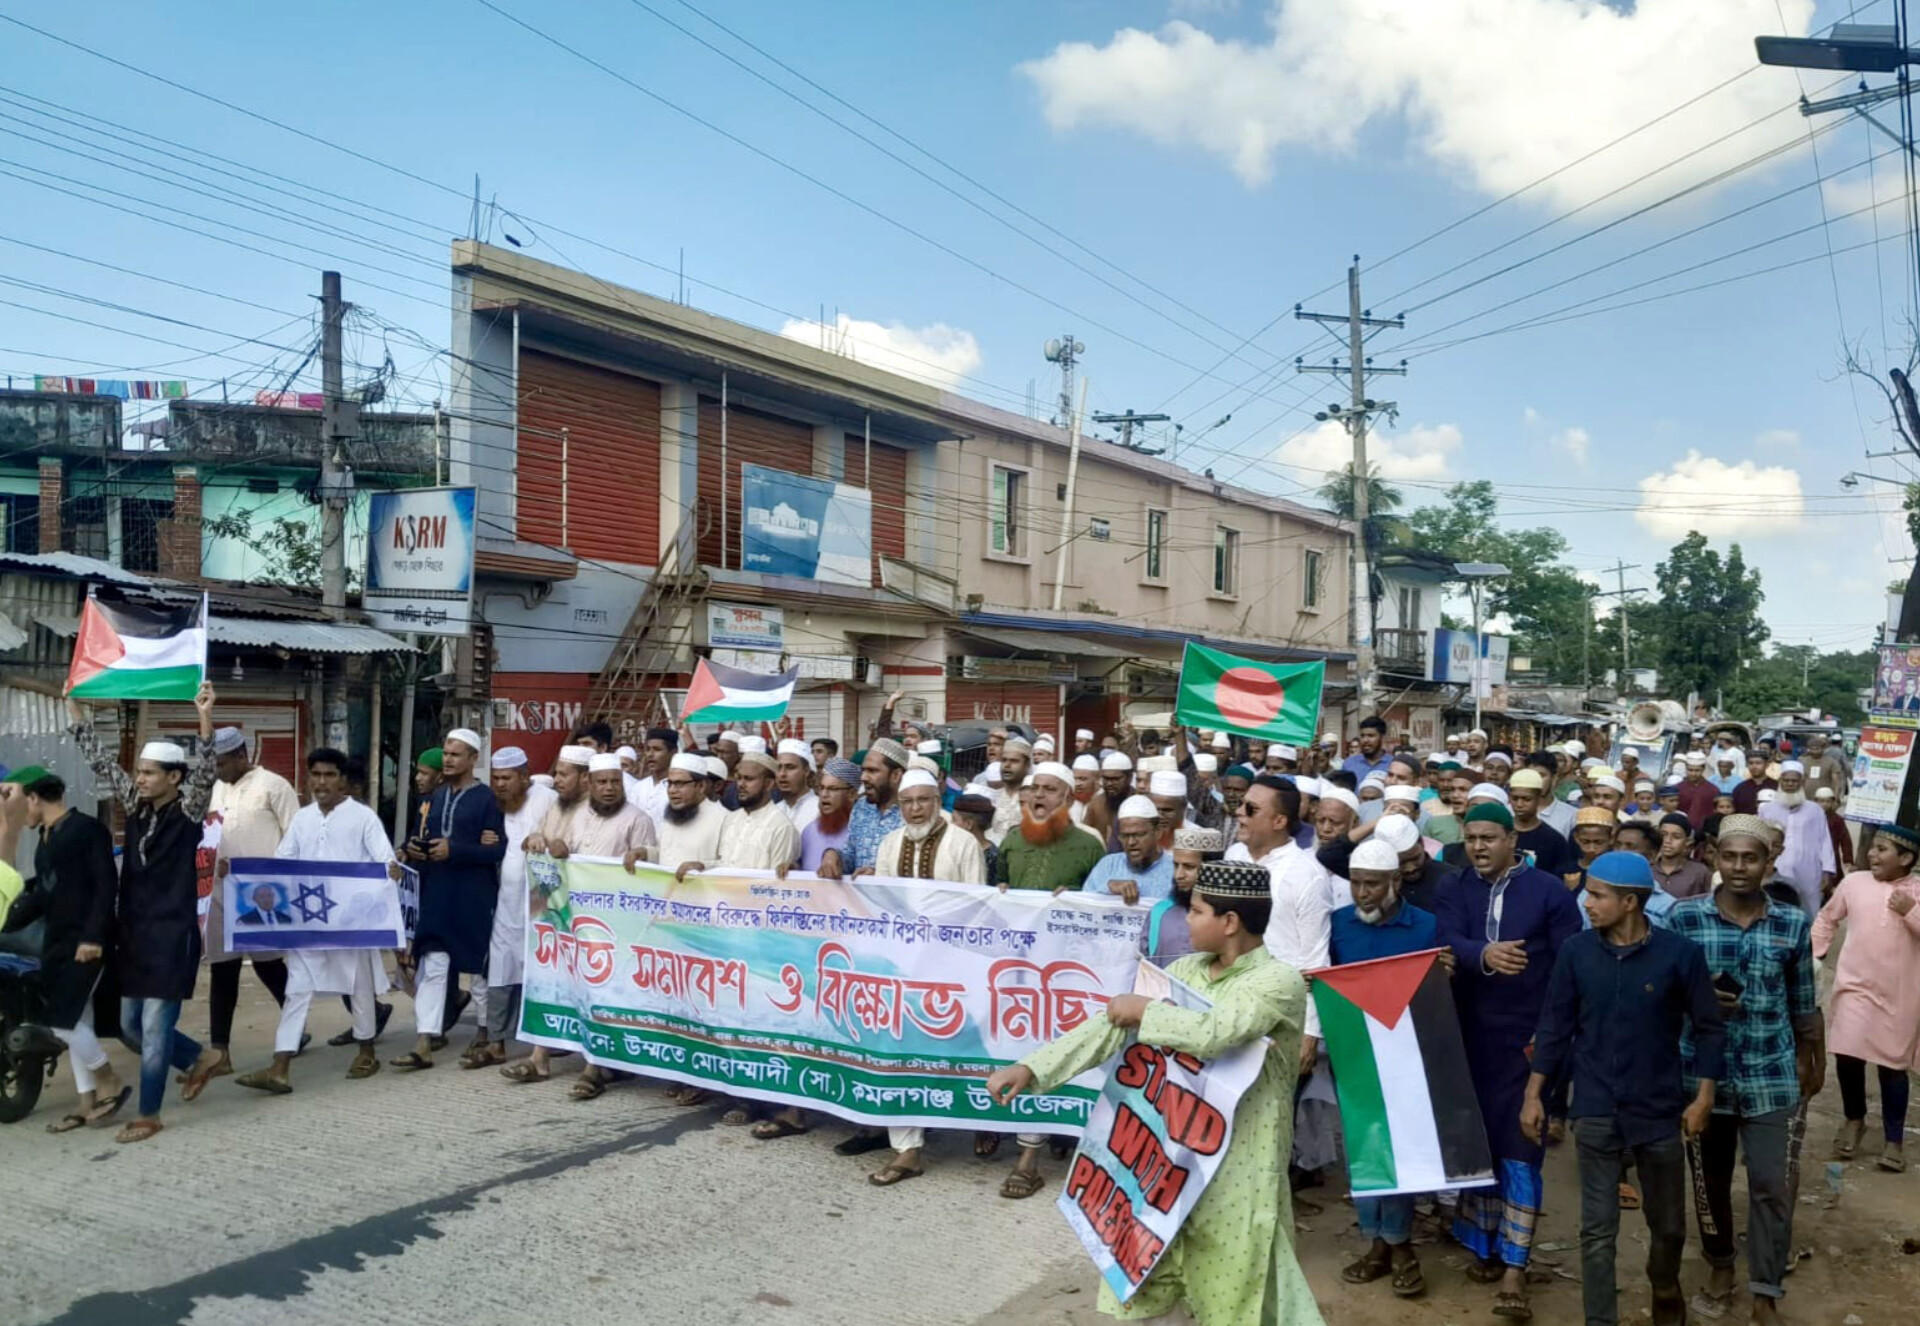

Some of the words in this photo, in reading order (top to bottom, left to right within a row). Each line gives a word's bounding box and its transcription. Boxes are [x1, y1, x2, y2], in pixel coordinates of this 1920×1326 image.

[394, 514, 447, 555] KSRM
[510, 700, 582, 735] KSRM
[716, 901, 761, 927] বিরুদ্ধে
[766, 904, 826, 931] ফিলিস্তিনের
[892, 915, 932, 944] বিপ্লবী
[938, 923, 994, 946] জনতার
[1000, 929, 1037, 950] পক্ষে
[630, 945, 747, 1015] সমাবেশ
[765, 965, 802, 1012] ও
[815, 942, 966, 1041] বিক্ষোভ
[987, 958, 1112, 1043] মিছি
[623, 1032, 686, 1064] উম্মতে
[691, 1056, 792, 1086] মোহাম্মাদী
[799, 1066, 845, 1102] (সা.)
[852, 1081, 954, 1110] কমলগঞ্জ
[1107, 1102, 1190, 1215] WITH
[1066, 1152, 1165, 1286] PALESTINE
